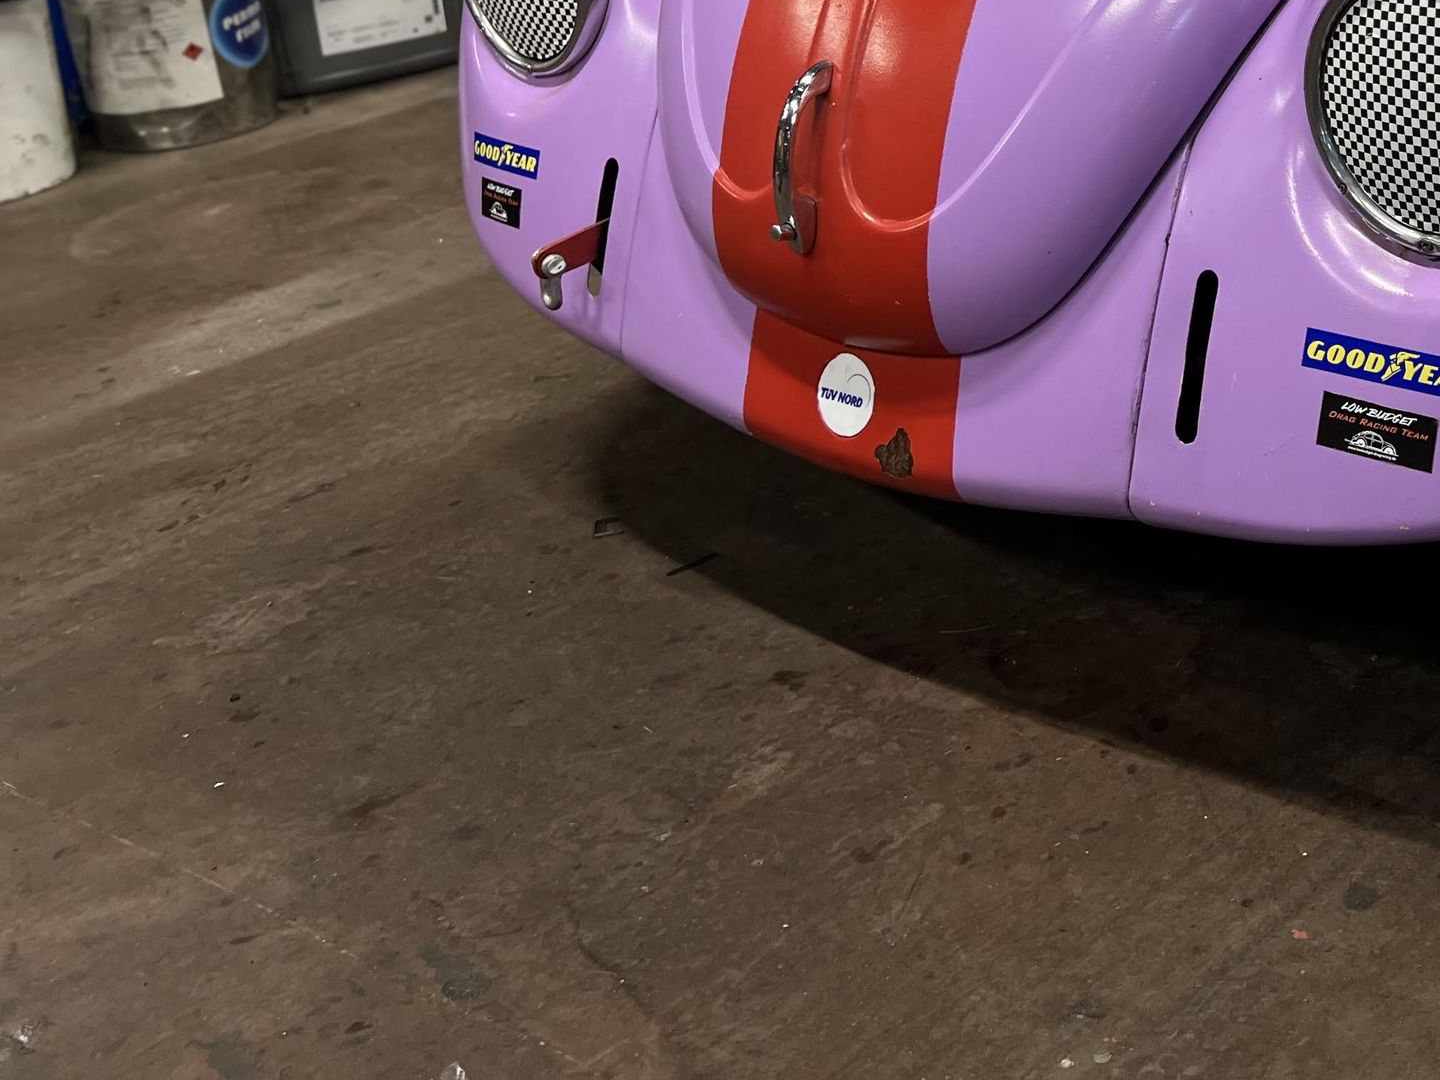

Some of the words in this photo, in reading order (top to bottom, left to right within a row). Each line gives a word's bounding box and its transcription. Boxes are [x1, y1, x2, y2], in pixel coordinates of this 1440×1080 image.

[474, 140, 537, 173] GOODYEAR
[838, 392, 864, 408] NORD
[1341, 401, 1368, 414] LOW
[1366, 408, 1418, 427] BUDGET
[1328, 410, 1357, 424] DRAG
[1360, 418, 1398, 434] RACING
[1401, 428, 1430, 441] TEAM
